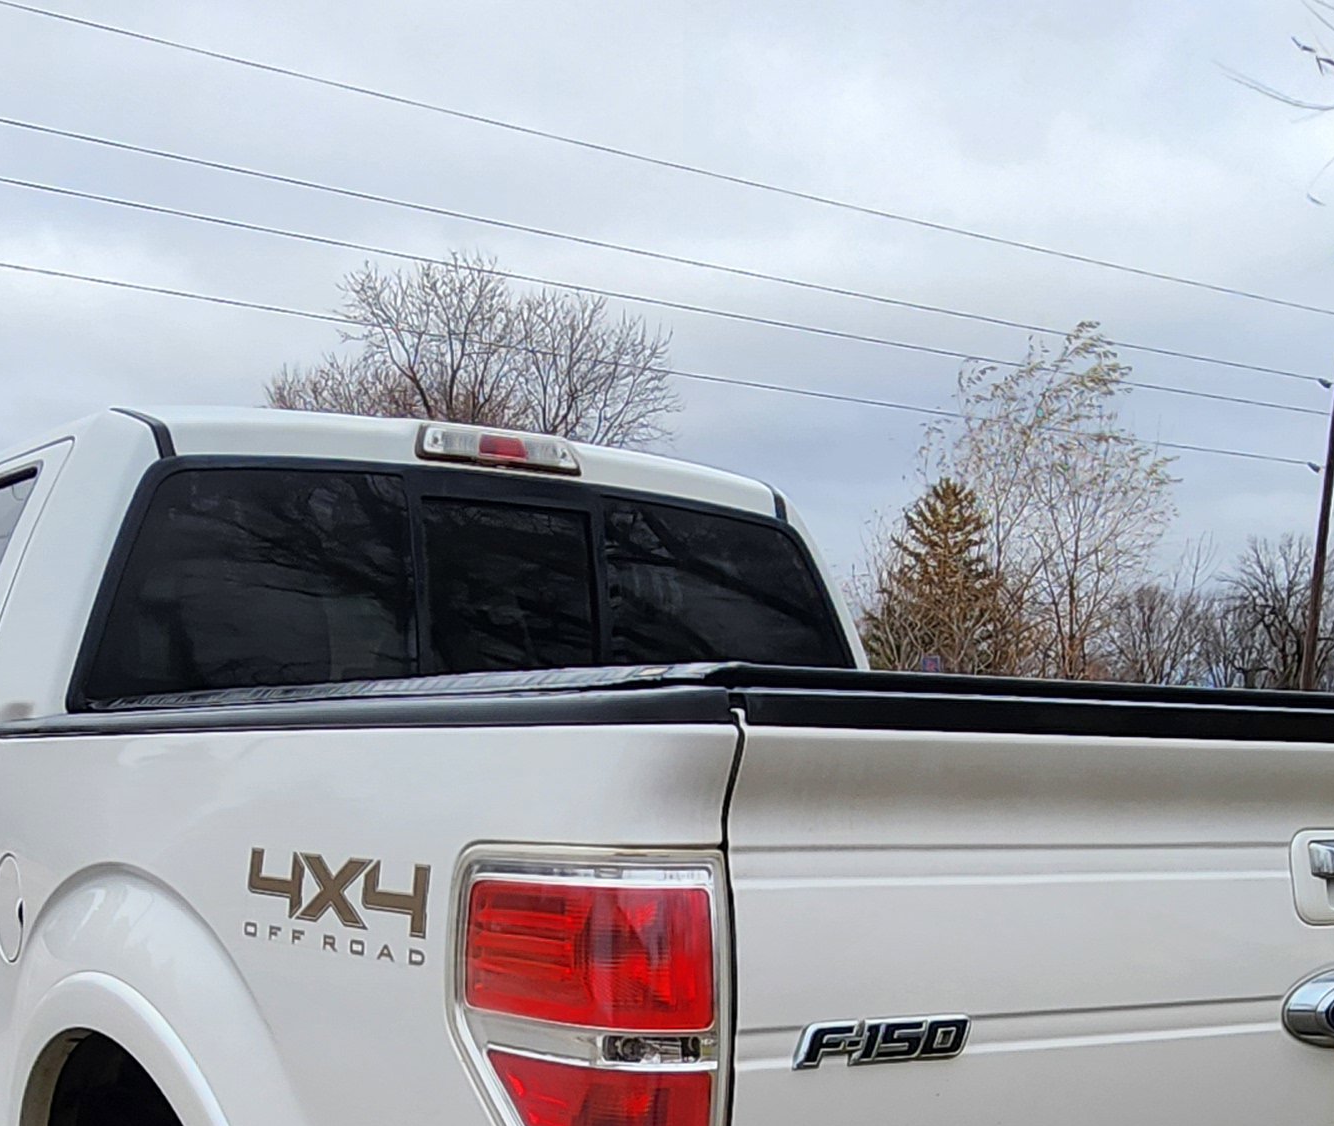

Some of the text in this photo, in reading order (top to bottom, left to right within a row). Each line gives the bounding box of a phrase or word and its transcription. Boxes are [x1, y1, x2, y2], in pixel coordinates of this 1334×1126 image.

[243, 920, 426, 966] OFF ROAD
[792, 1013, 972, 1071] F-150
